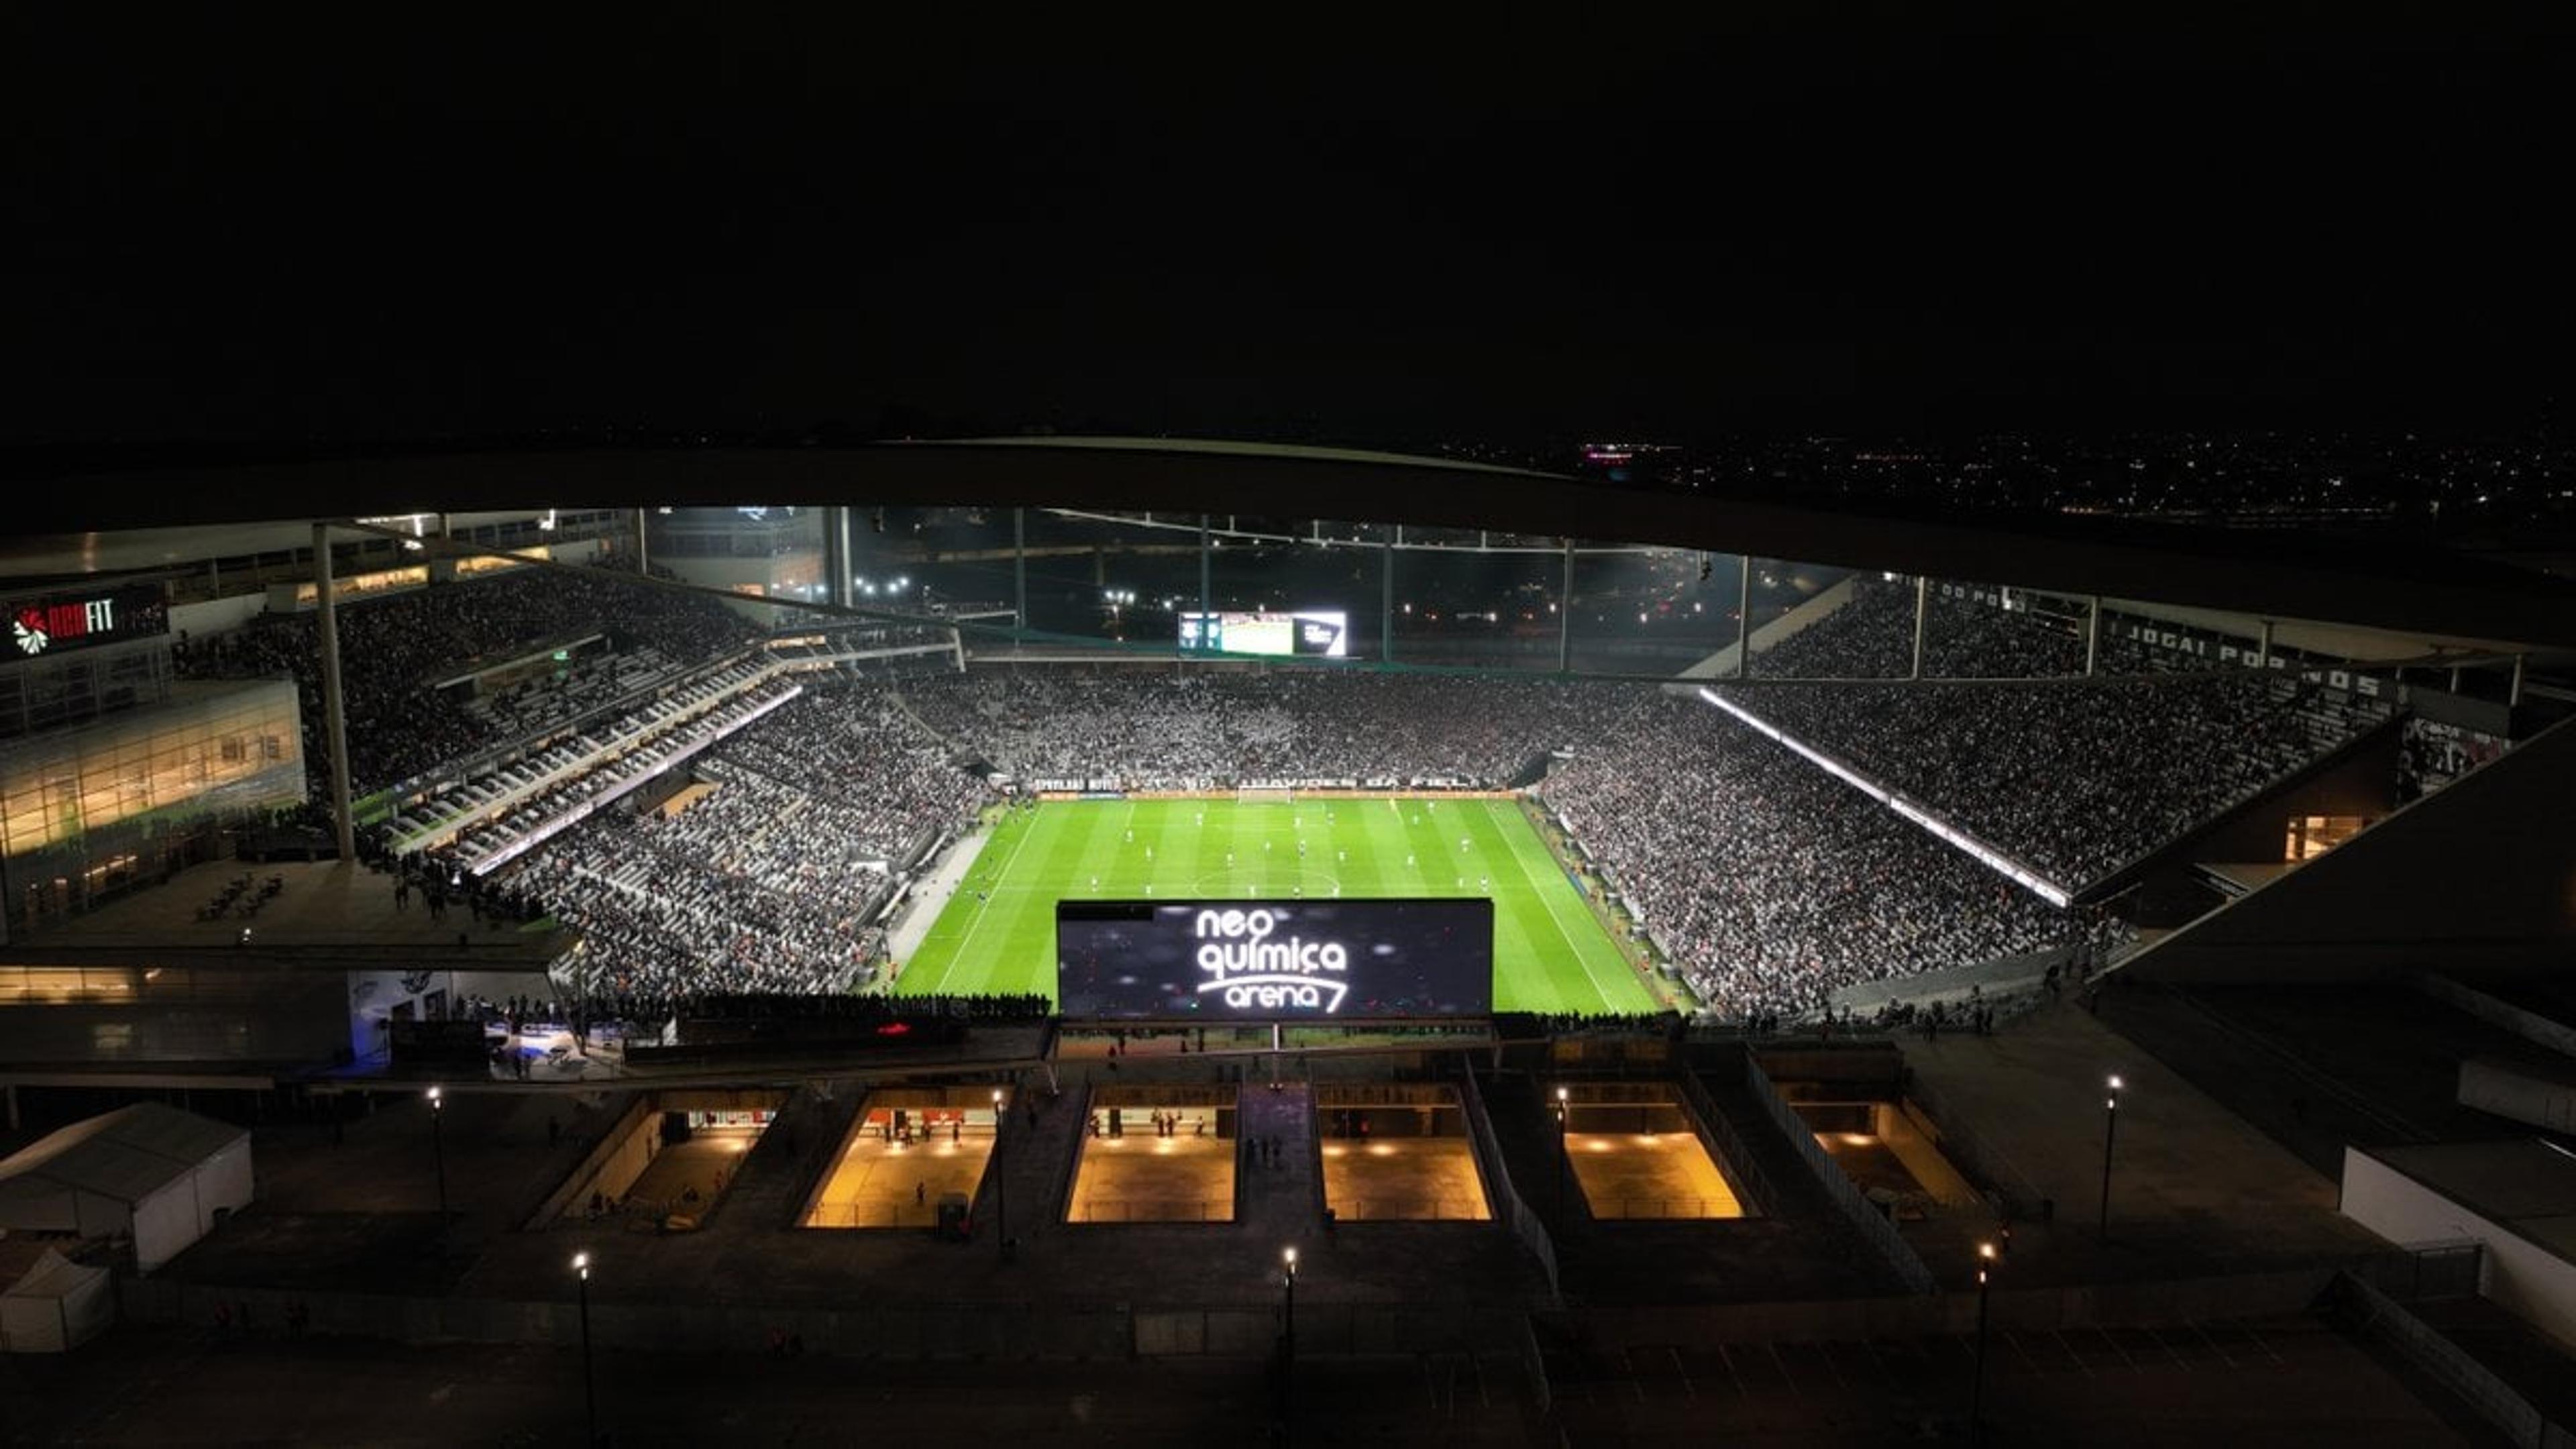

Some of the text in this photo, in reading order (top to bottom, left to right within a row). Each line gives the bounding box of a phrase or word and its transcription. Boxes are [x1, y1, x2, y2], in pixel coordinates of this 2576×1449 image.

[1974, 590, 2026, 614] POO
[2128, 625, 2206, 655] JOGAI
[1197, 909, 1274, 937] neo
[1225, 985, 1320, 1008] arena
